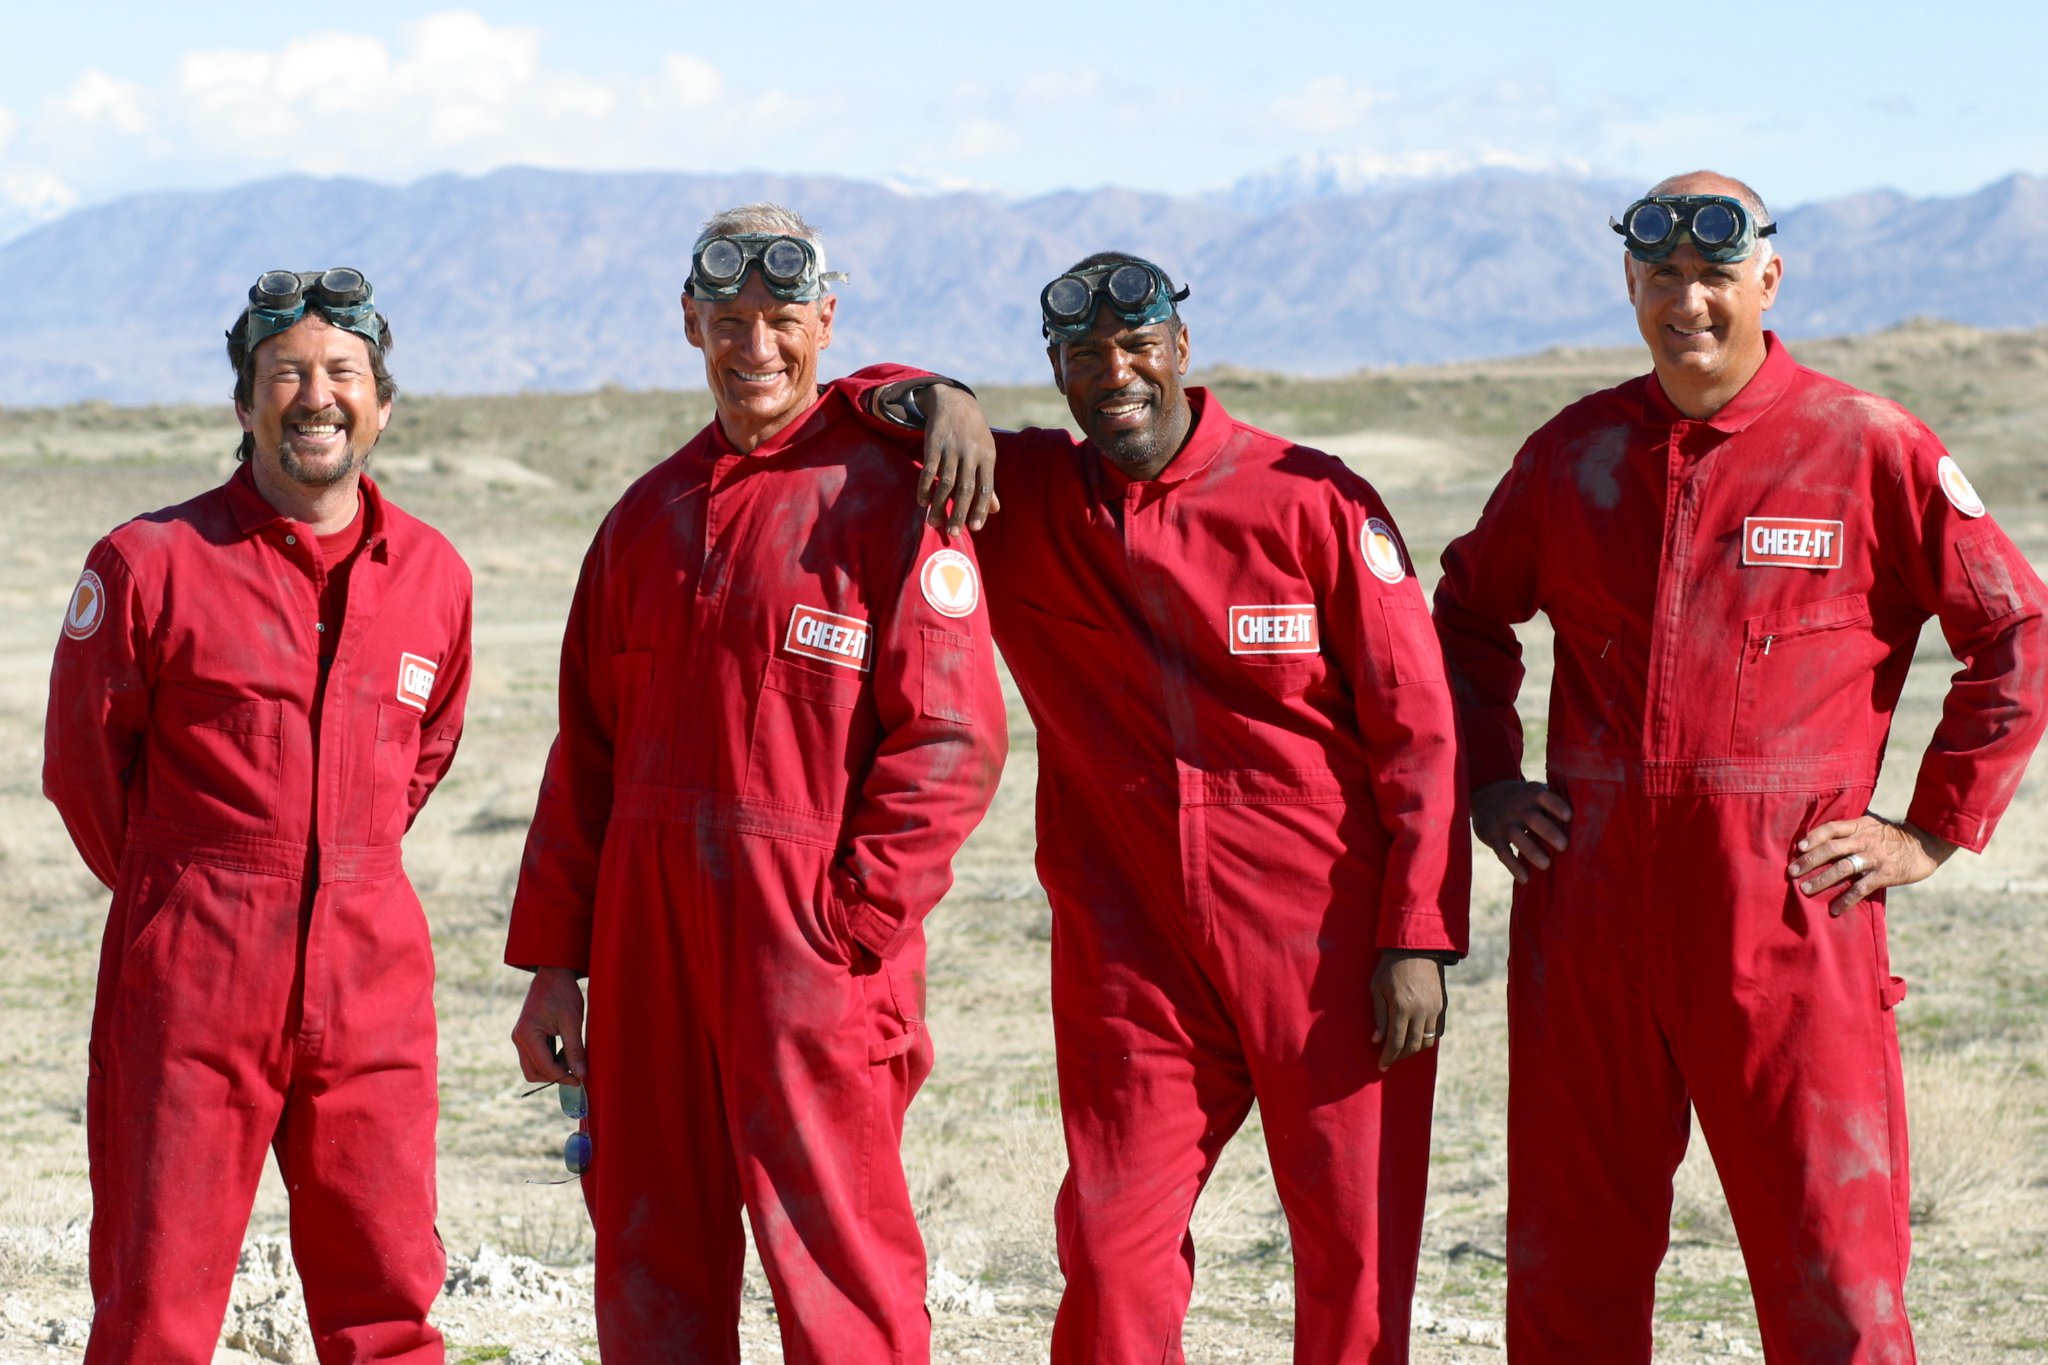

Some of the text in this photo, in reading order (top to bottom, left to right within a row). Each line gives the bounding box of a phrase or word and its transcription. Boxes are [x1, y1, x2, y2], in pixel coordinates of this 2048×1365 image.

[1751, 526, 1835, 558] CHEEZ-IT
[796, 615, 869, 660] CHEEZ-IT
[1237, 613, 1312, 644] CHEEZ-IT
[404, 663, 435, 701] CHEE
